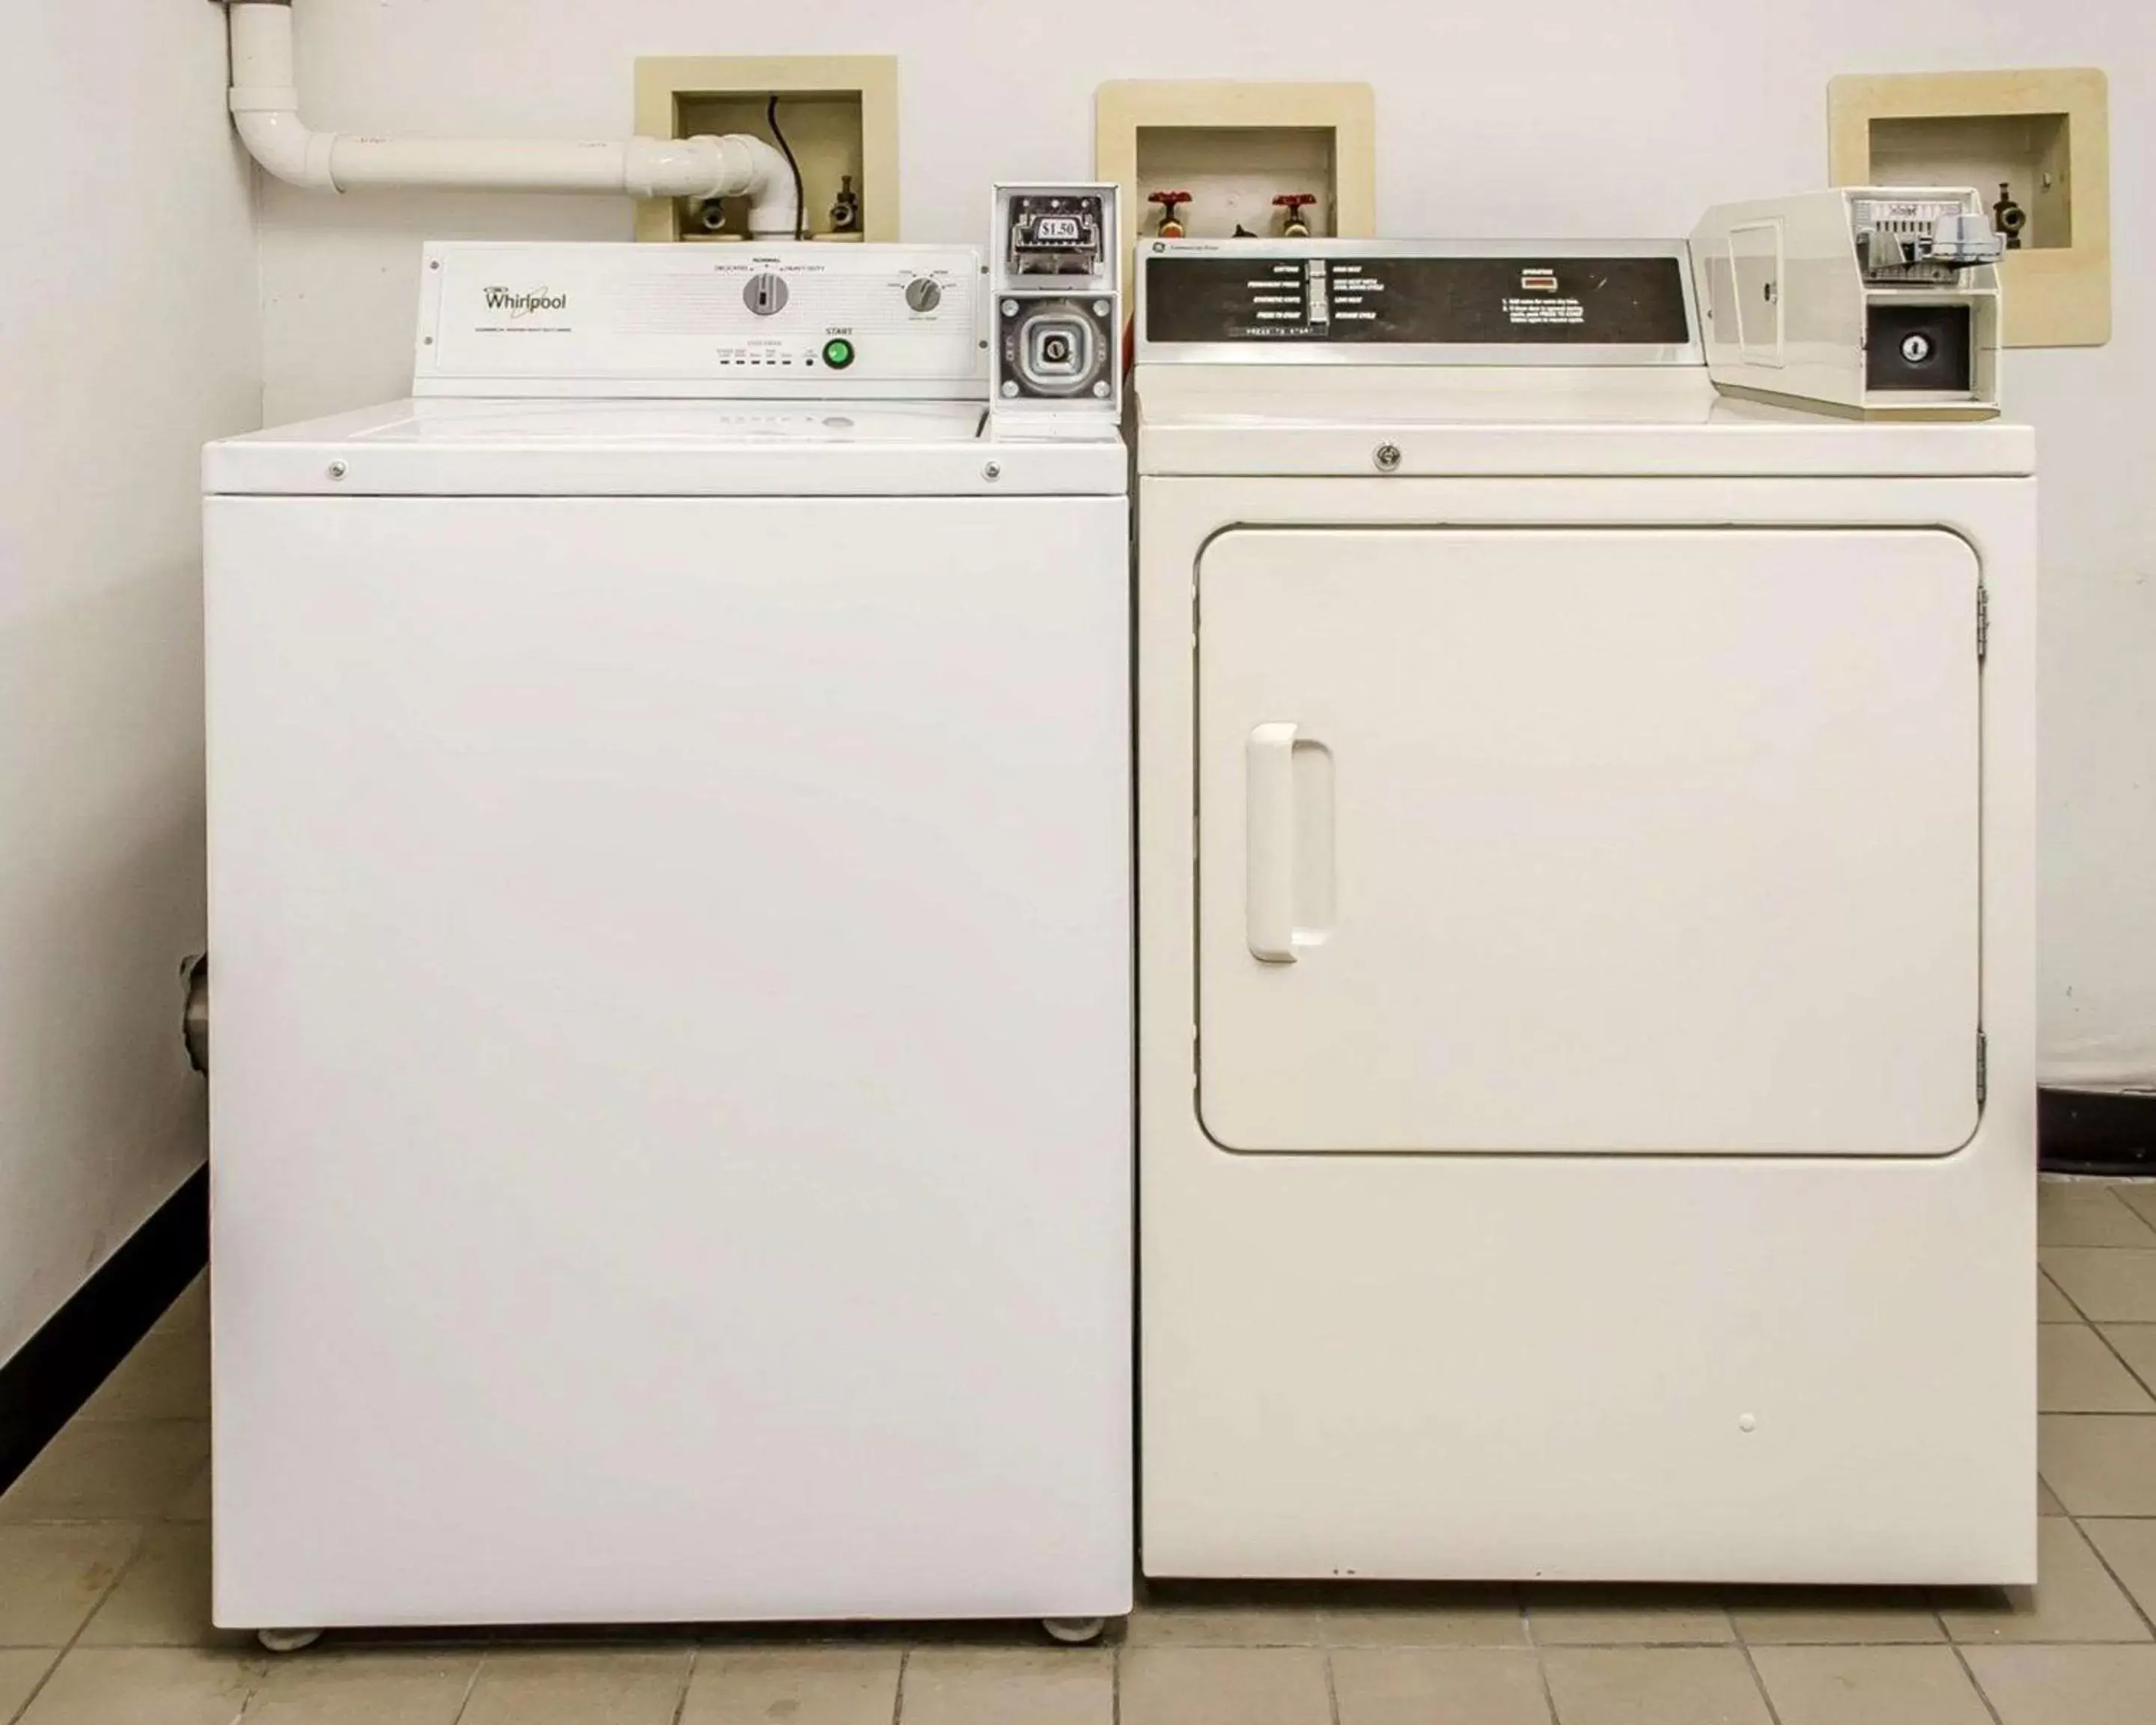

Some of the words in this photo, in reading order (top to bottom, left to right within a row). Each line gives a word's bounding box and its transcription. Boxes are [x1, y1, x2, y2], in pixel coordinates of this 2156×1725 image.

[1041, 222, 1075, 236] $1.50
[485, 293, 566, 313] Whirlpool
[825, 327, 853, 335] START
